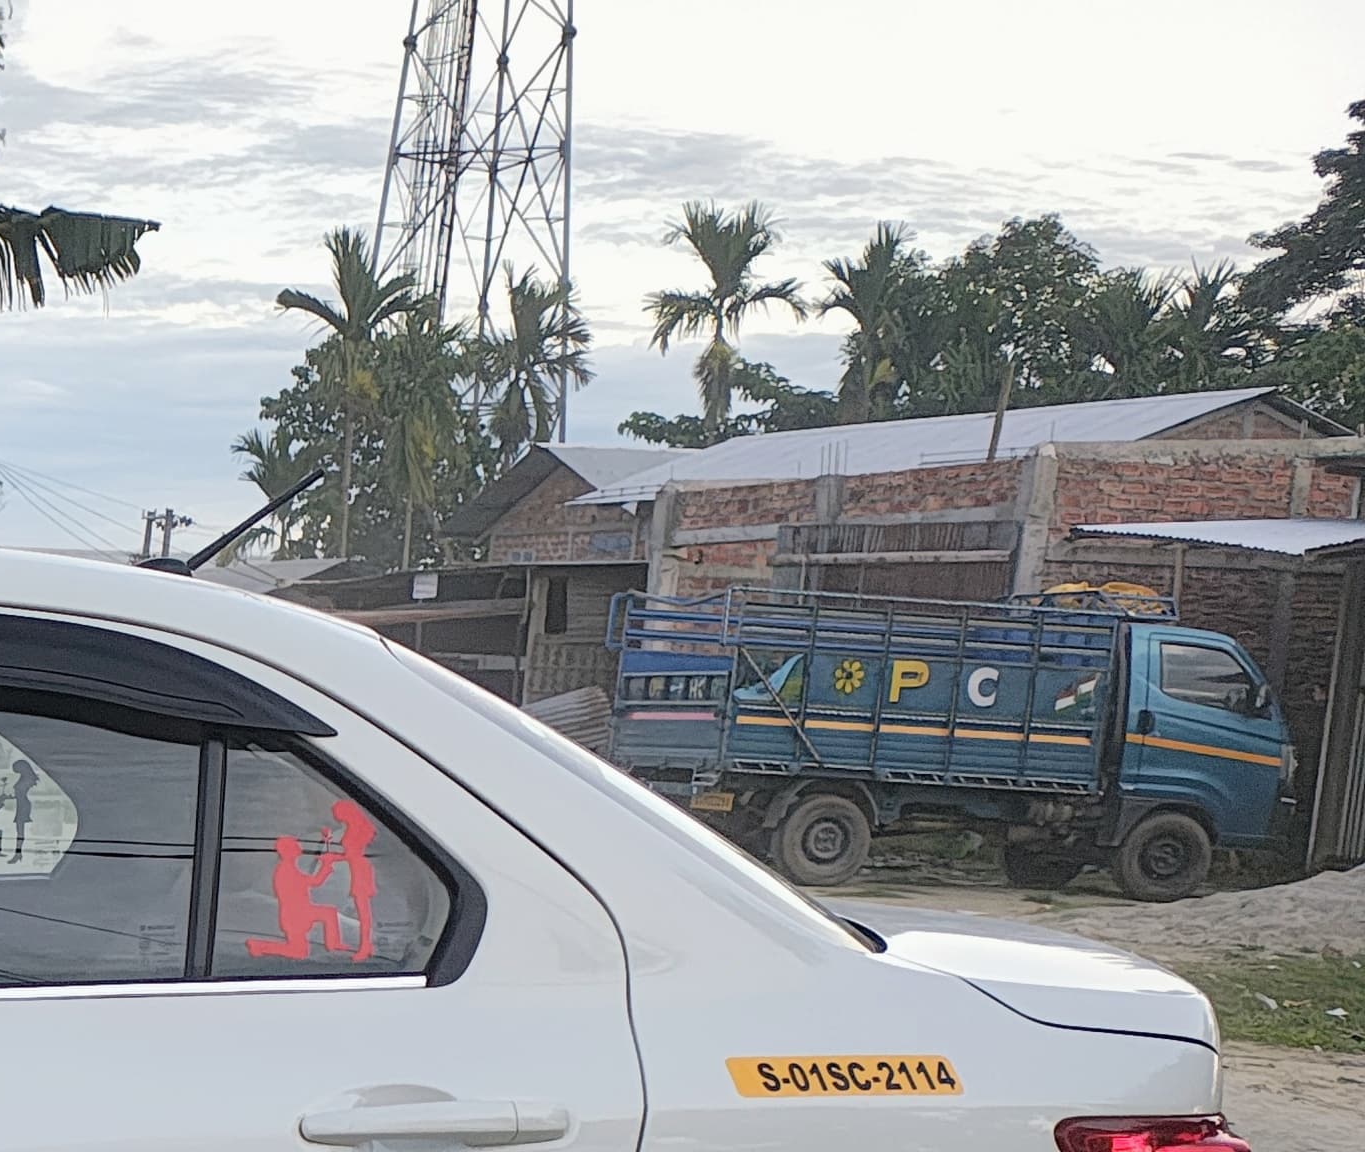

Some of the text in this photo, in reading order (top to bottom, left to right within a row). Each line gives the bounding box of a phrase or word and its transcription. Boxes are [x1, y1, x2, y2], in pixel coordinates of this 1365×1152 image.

[889, 660, 999, 707] P C
[757, 1061, 956, 1092] S-01SC-2114
